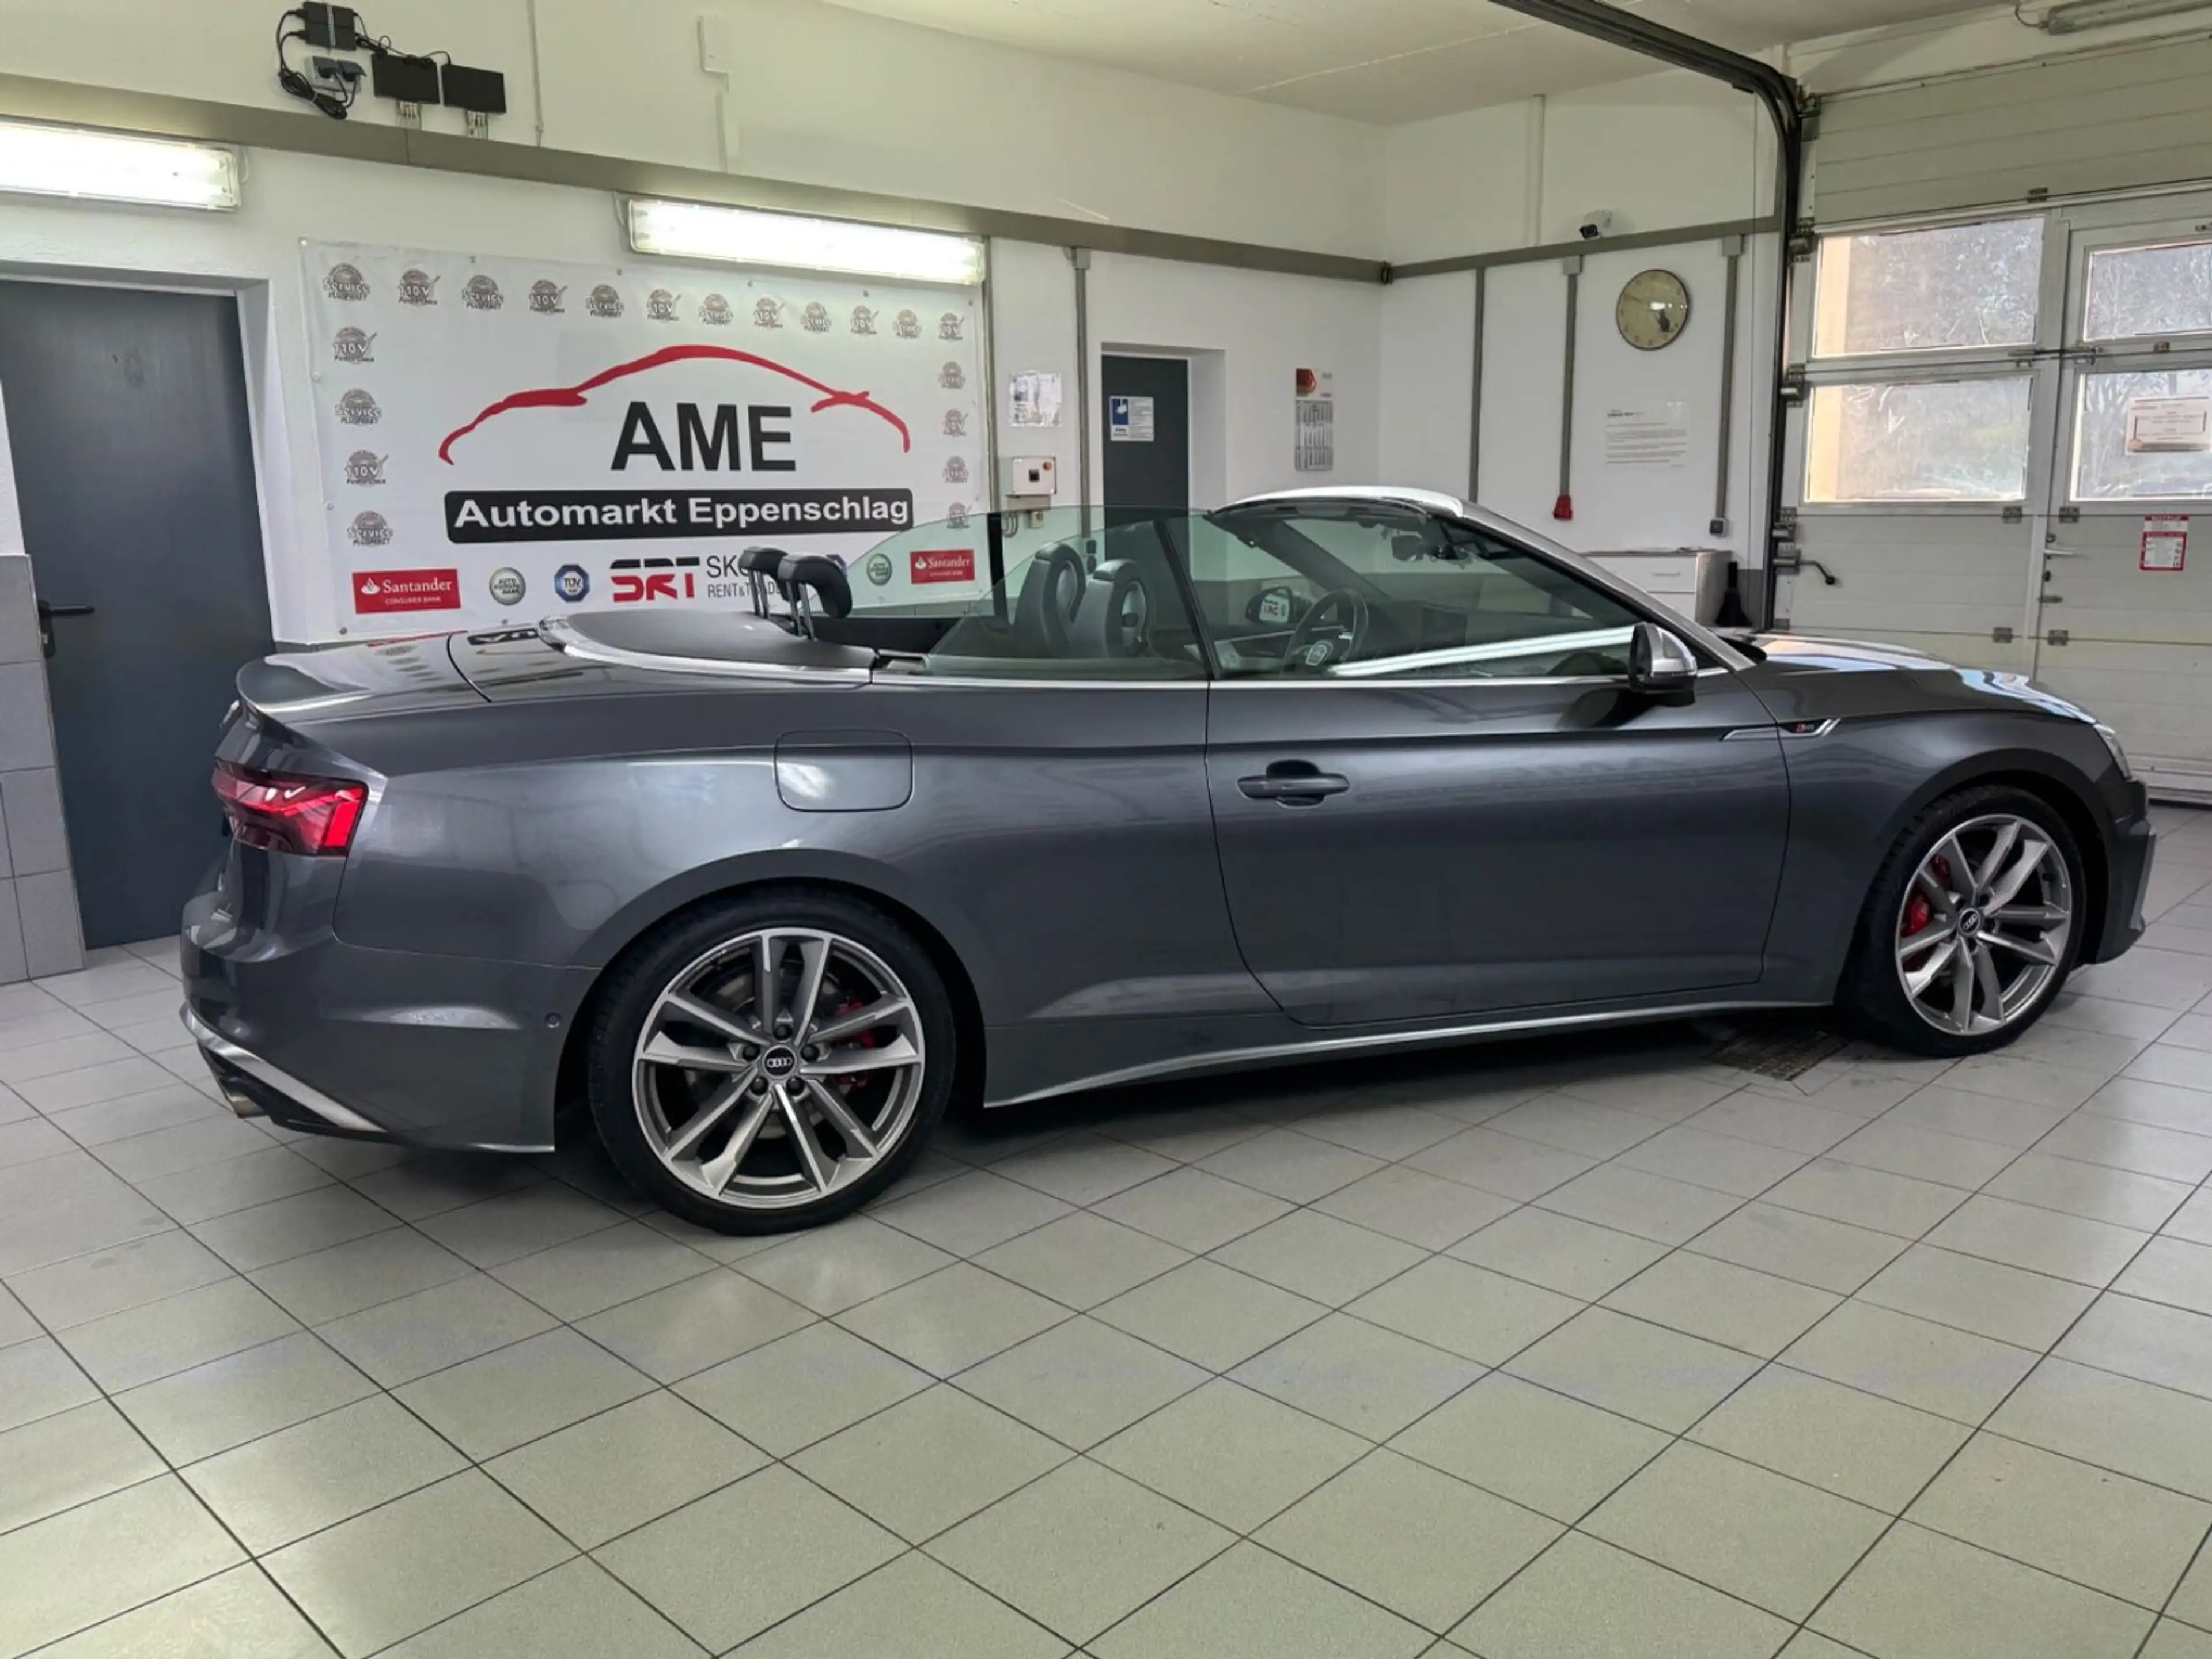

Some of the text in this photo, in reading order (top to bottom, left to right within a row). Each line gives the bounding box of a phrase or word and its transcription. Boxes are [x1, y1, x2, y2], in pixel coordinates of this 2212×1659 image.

[610, 402, 796, 471] AME
[454, 497, 908, 528] Automarkt Eppenschlag
[927, 555, 969, 569] Santander
[382, 577, 452, 594] Santander
